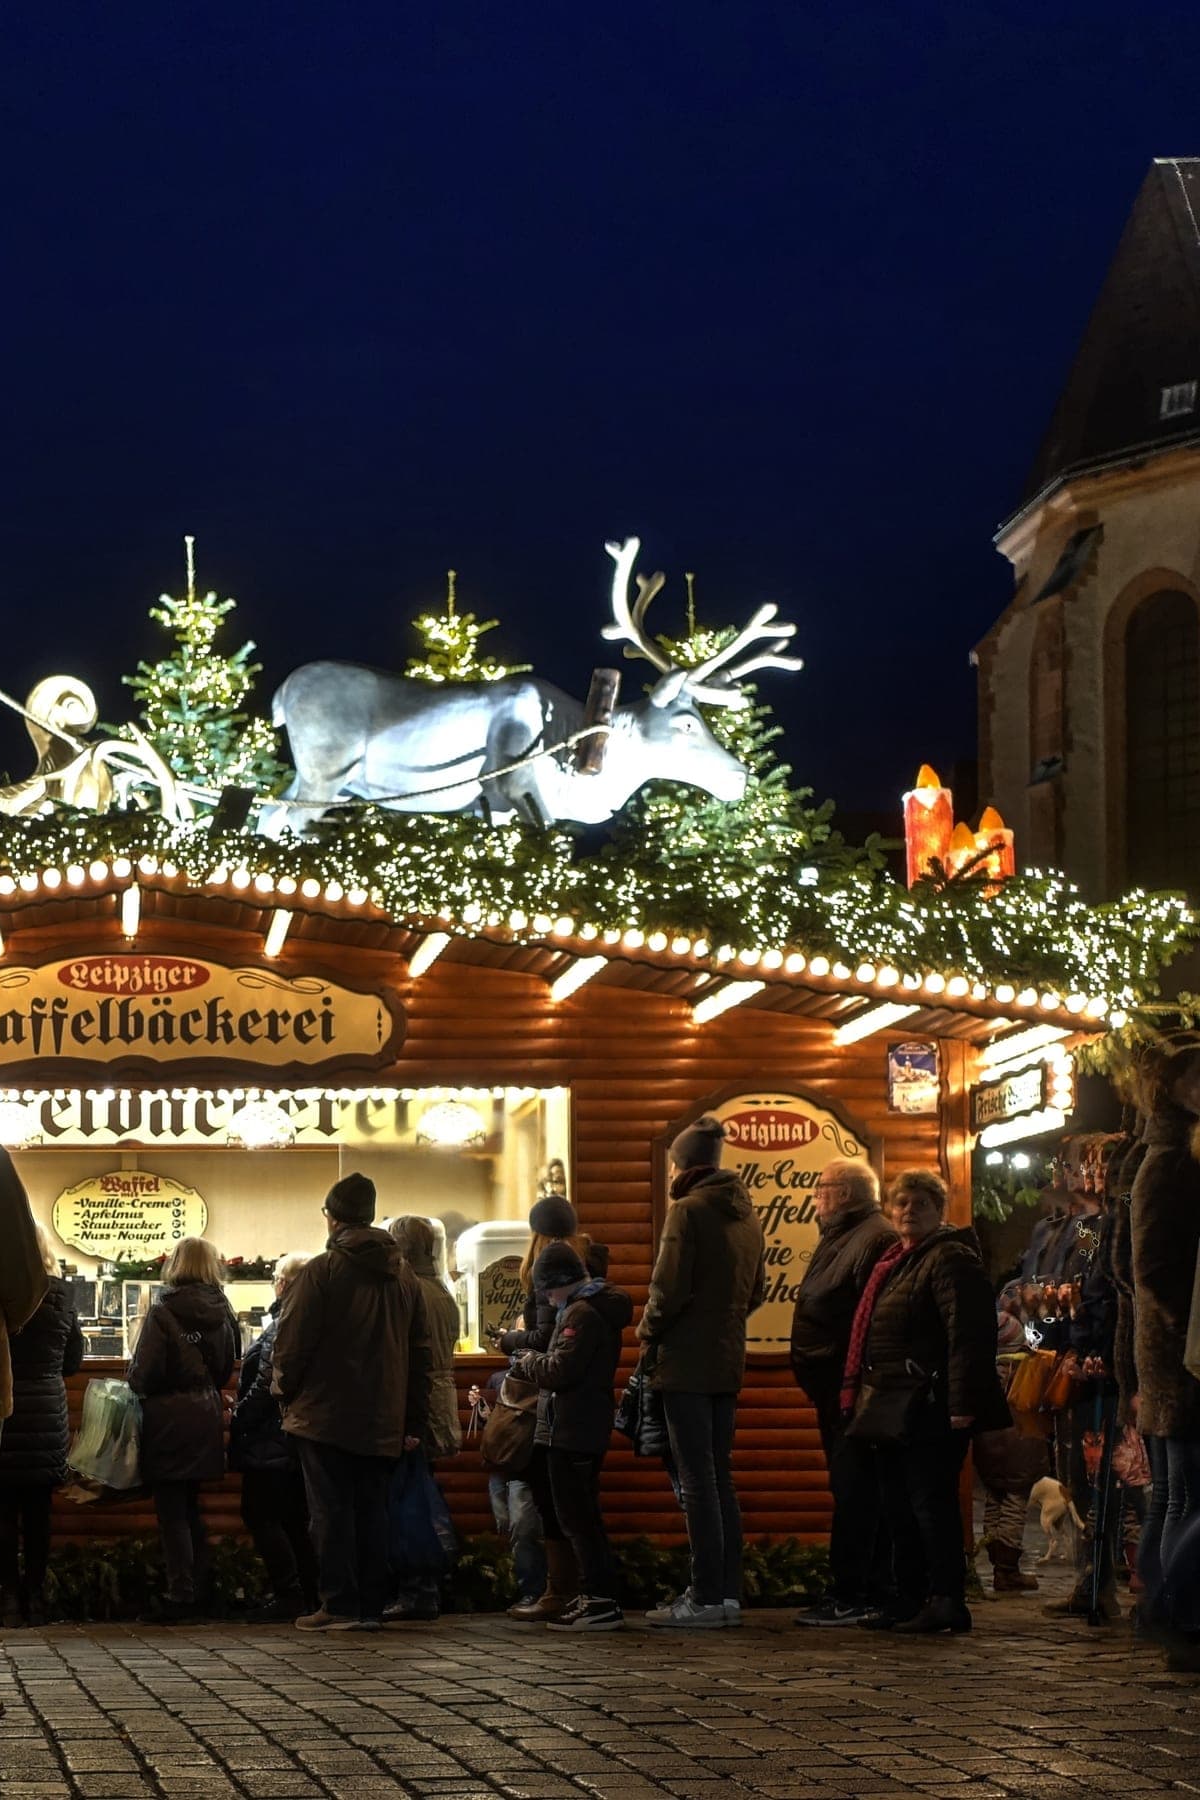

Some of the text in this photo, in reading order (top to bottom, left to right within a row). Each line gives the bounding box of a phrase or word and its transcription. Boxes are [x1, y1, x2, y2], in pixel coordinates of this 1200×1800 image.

[70, 959, 197, 992] Leipziger
[724, 1116, 812, 1147] Original
[101, 1175, 161, 1195] Waffel
[765, 1239, 794, 1266] ie
[485, 1288, 528, 1315] Waffe
